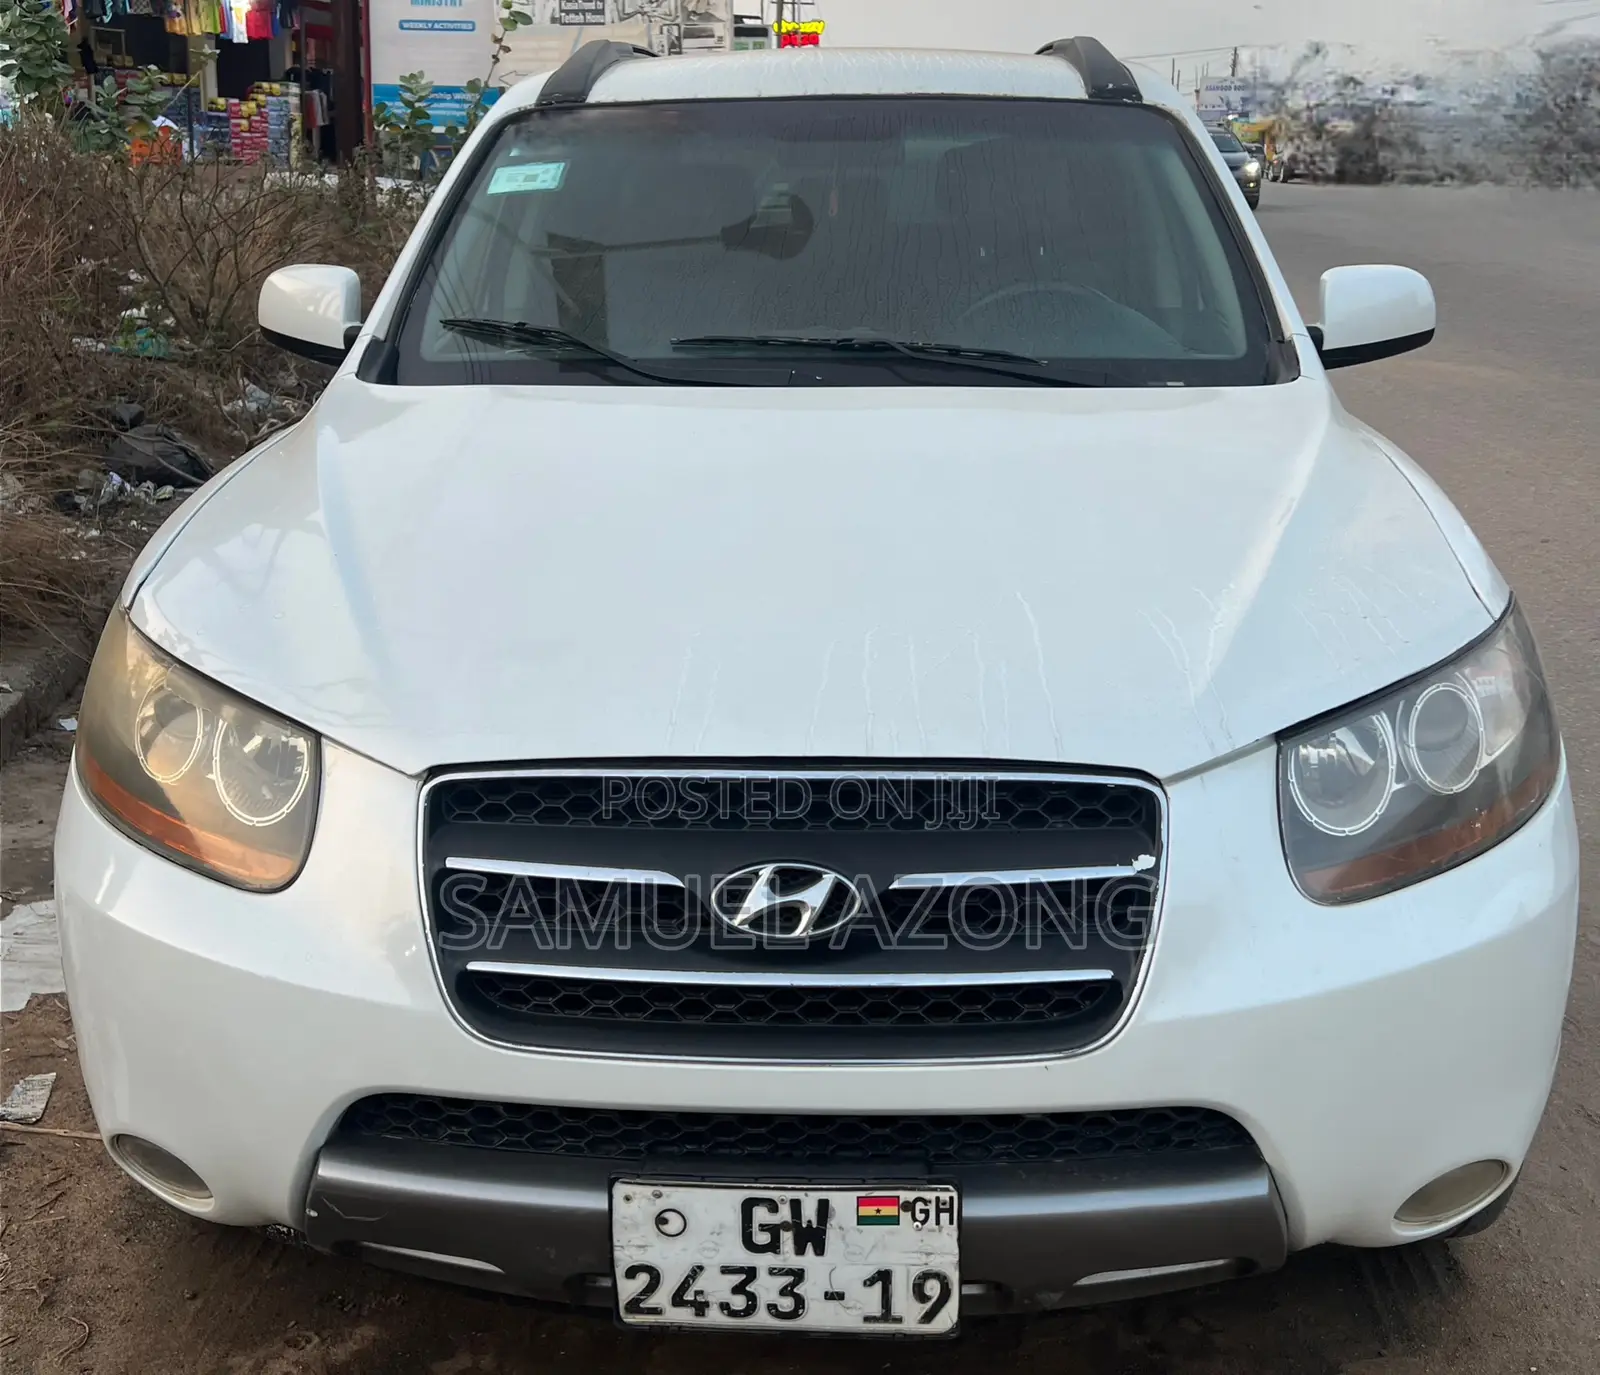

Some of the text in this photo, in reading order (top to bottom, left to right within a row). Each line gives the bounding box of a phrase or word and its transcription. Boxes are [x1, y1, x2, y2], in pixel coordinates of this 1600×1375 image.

[433, 22, 473, 30] ACTIVITIES
[741, 1196, 955, 1257] GW GH
[623, 1264, 953, 1325] 2433-19
